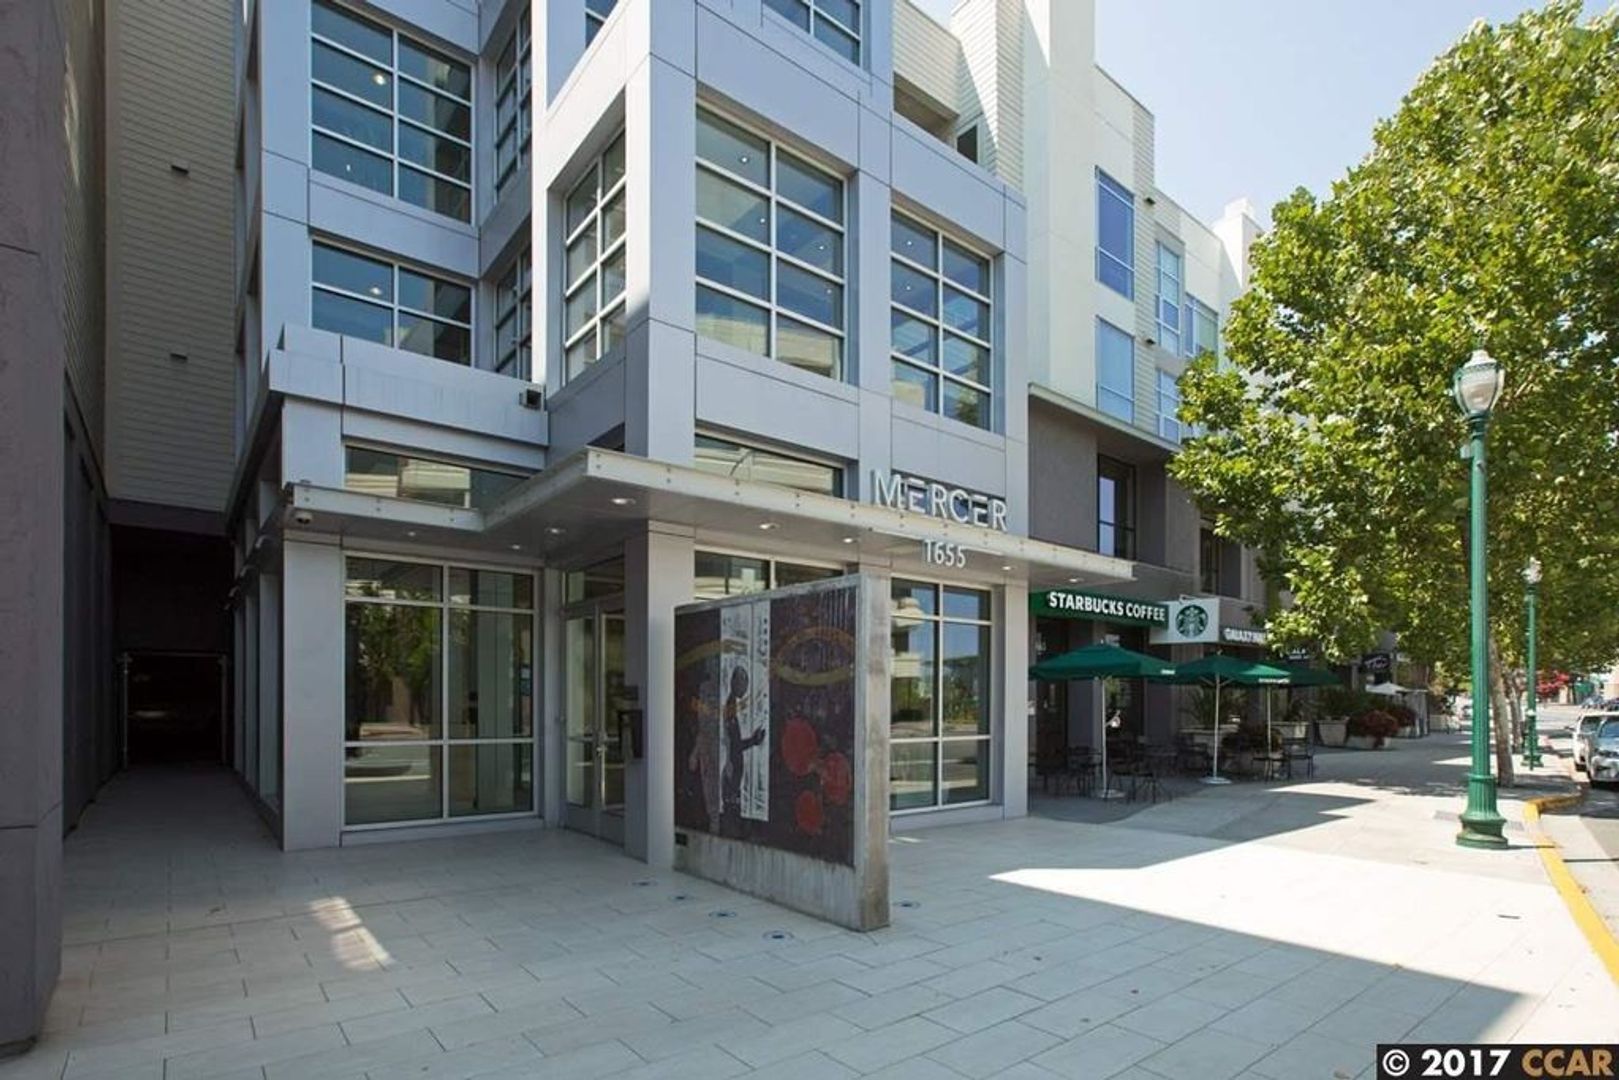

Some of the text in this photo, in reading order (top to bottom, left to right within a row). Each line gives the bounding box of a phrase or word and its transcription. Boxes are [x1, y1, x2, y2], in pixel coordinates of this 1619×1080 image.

[873, 469, 1007, 532] MERCER
[924, 539, 966, 568] 1655
[1048, 591, 1166, 621] STARBUCKS COFFEE
